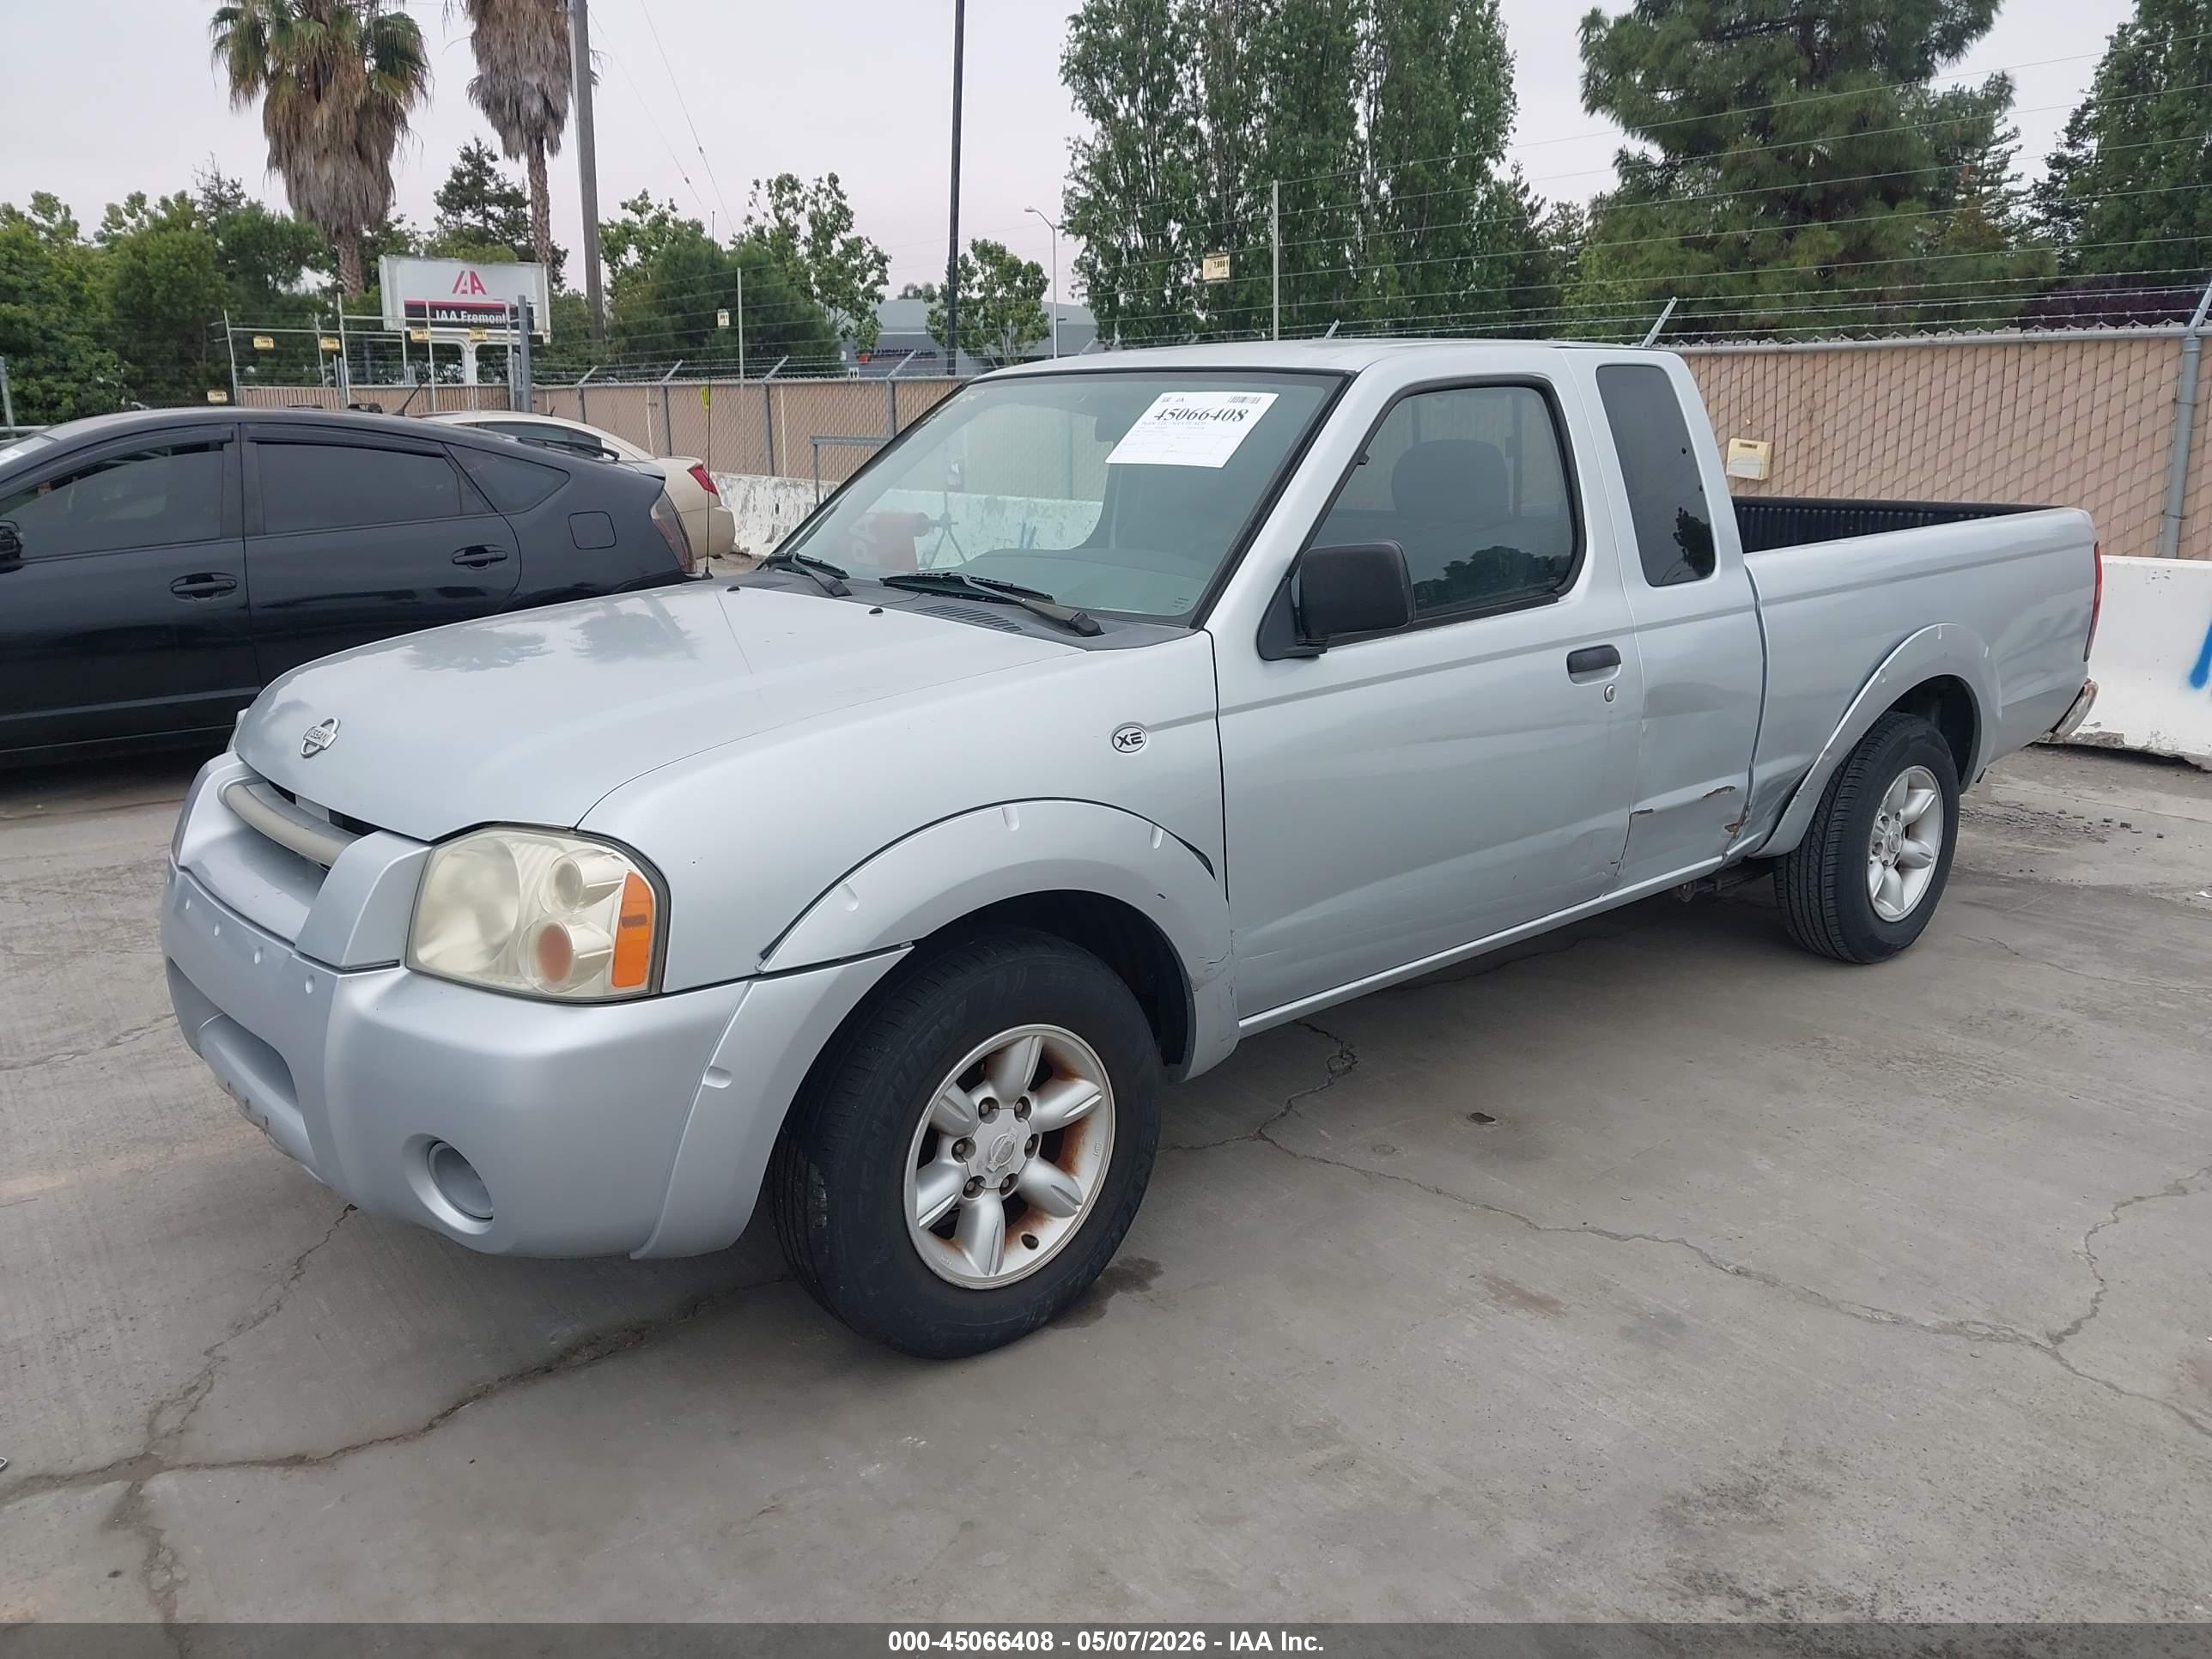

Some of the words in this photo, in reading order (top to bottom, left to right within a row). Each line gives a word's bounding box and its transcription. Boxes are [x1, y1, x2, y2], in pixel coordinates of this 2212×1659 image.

[435, 309, 457, 322] IAA
[459, 311, 506, 325] Fremont
[1154, 408, 1249, 422] 45066408
[1117, 732, 1143, 748] XE
